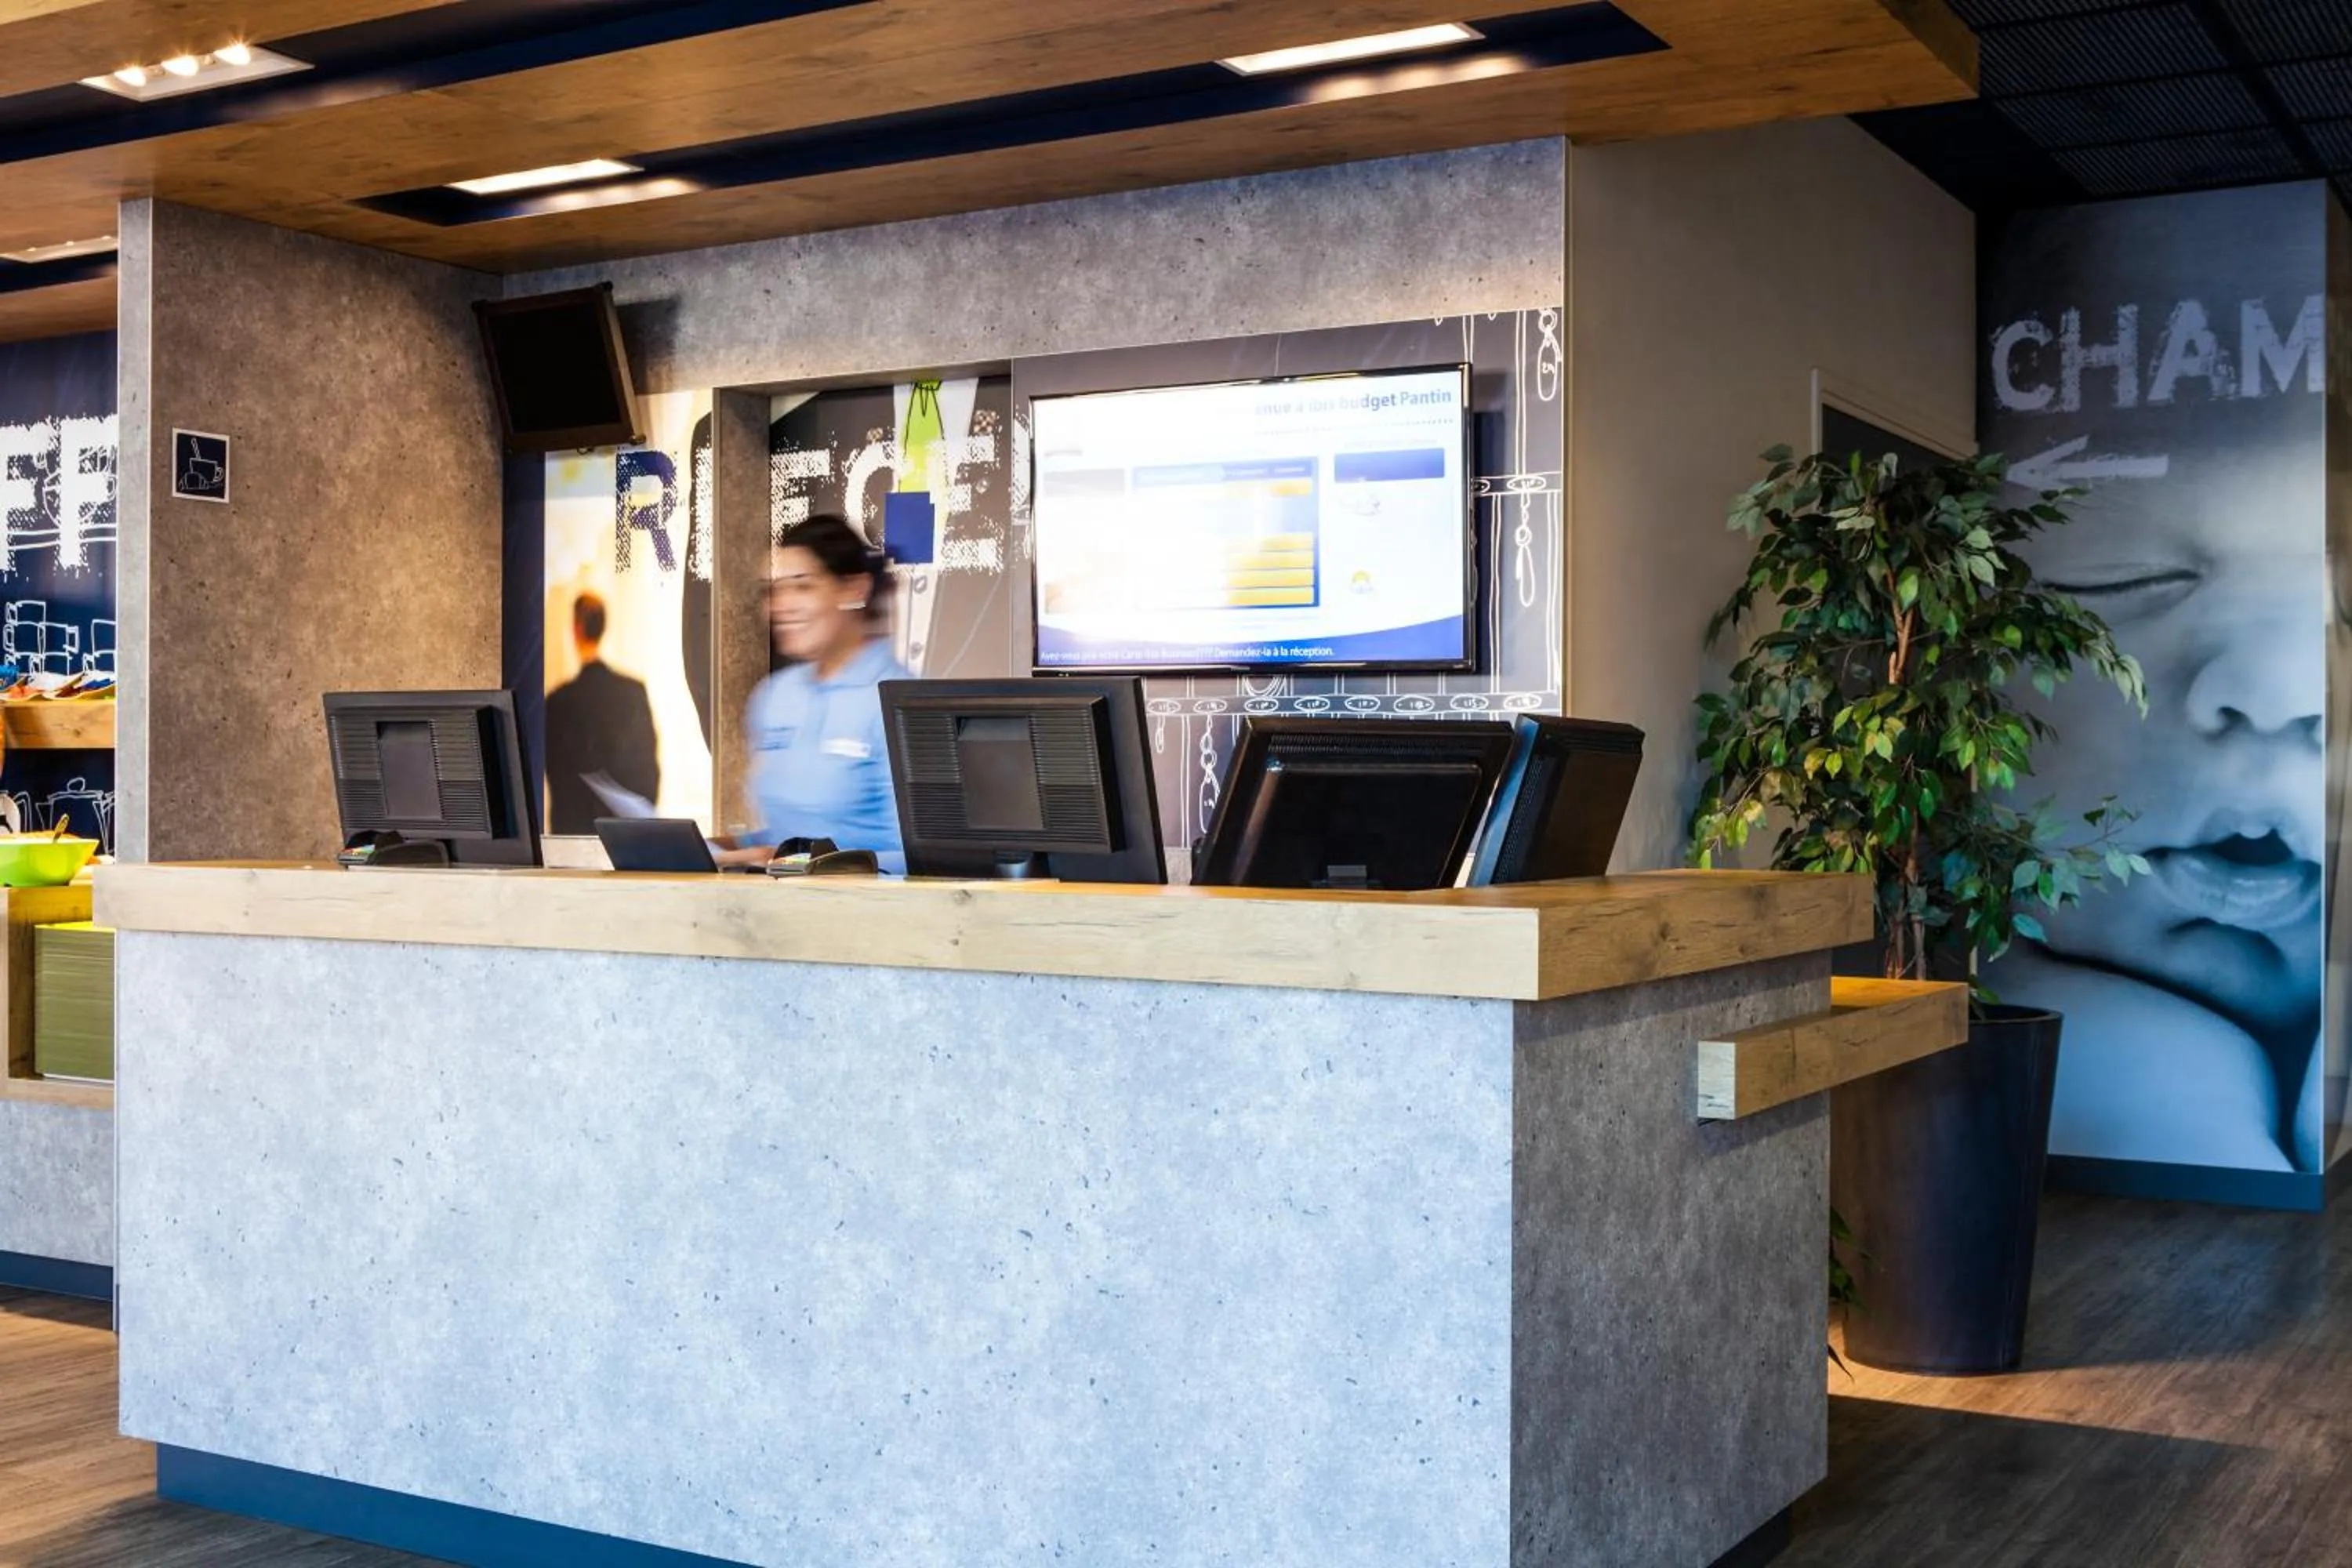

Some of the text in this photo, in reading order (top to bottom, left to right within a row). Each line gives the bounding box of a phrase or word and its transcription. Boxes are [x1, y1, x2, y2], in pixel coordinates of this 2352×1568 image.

[1338, 393, 1396, 411] budget
[1400, 389, 1451, 405] Pantin
[1273, 646, 1279, 656] à
[1280, 645, 1288, 656] la
[1290, 645, 1335, 659] réception.
